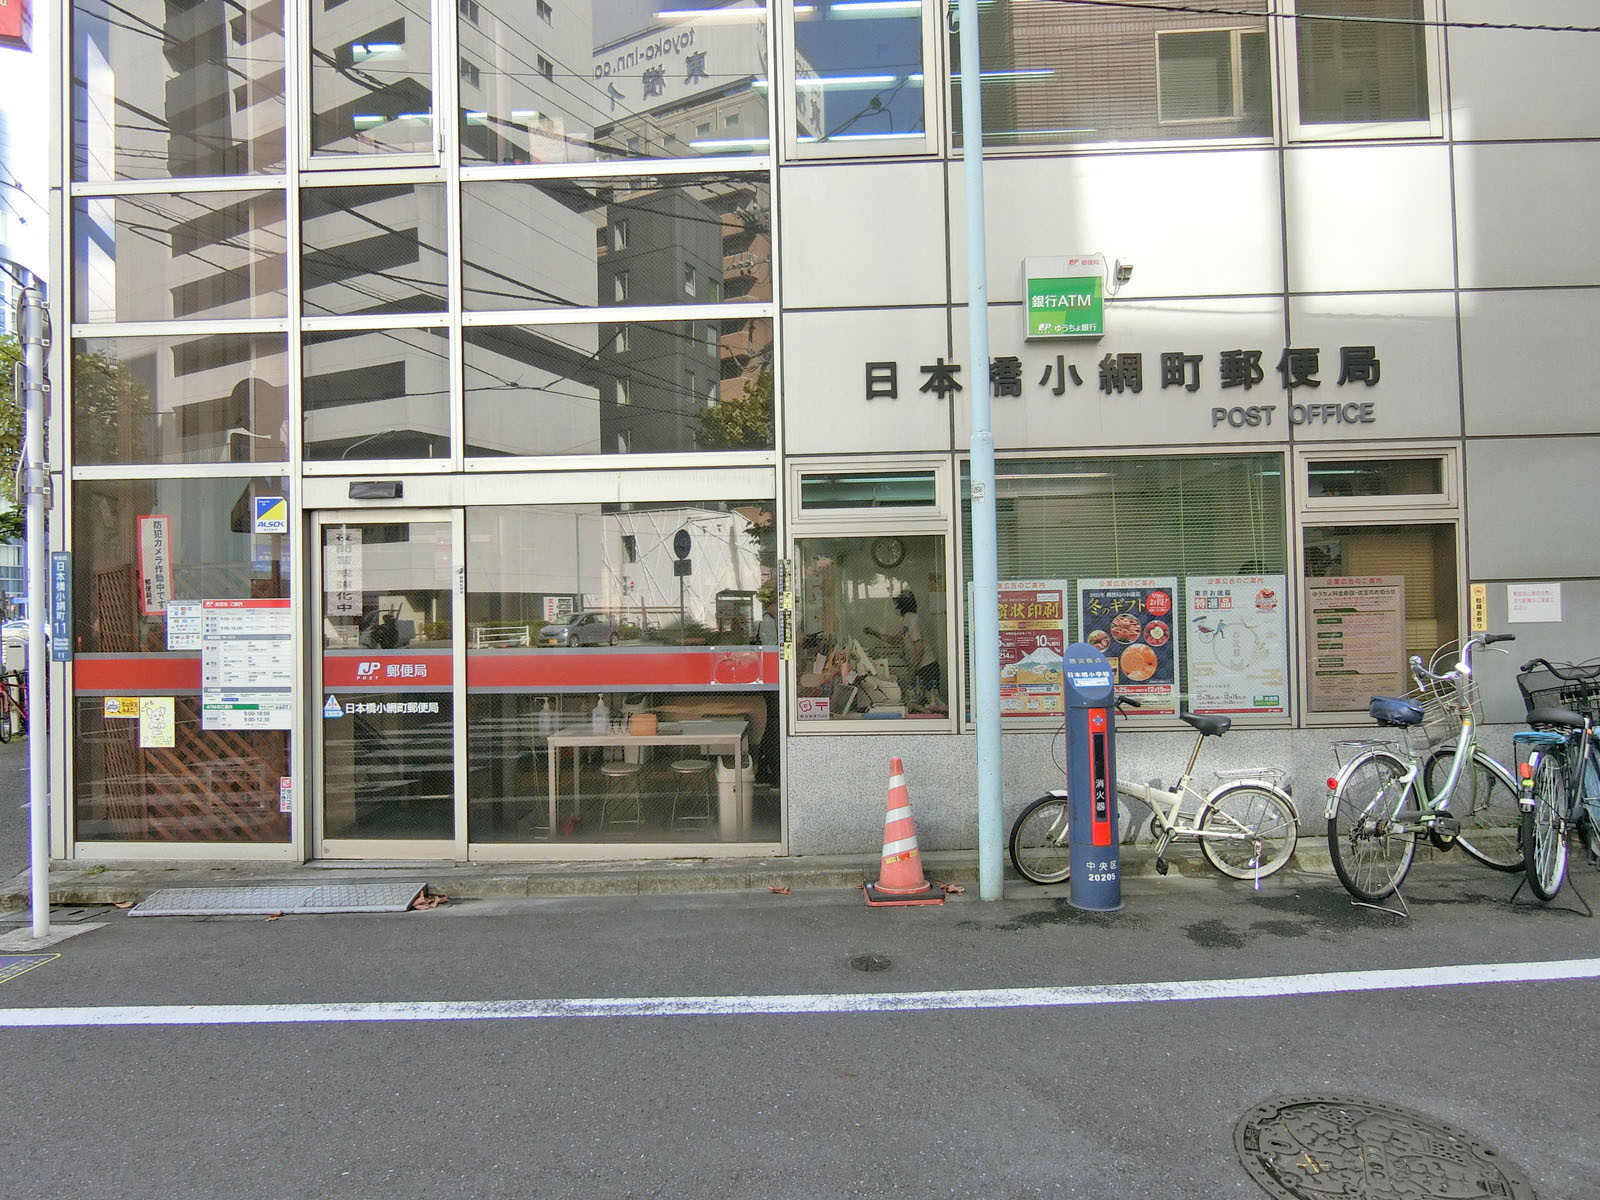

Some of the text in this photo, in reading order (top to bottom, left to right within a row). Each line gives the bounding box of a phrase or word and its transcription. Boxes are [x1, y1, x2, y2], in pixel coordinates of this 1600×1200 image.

[1031, 294, 1091, 308] 銀行ATM
[1054, 323, 1096, 332] ゆうちょ銀行
[866, 345, 1381, 401] 日本橋小網町郵便局
[1212, 402, 1376, 428] POST OFFICE
[56, 561, 66, 621] 日本橋小網町
[998, 602, 1060, 619] 賀状印刷
[1087, 598, 1146, 616] 冬のギフト
[54, 622, 66, 634] 11
[386, 664, 427, 678] 郵便局
[1067, 671, 1111, 679] 日本橋小学校
[345, 702, 440, 715] 日本橋小網町郵便局
[1095, 778, 1106, 812] 消火器
[1086, 859, 1117, 871] 中央区
[1088, 873, 1116, 882] 20205
